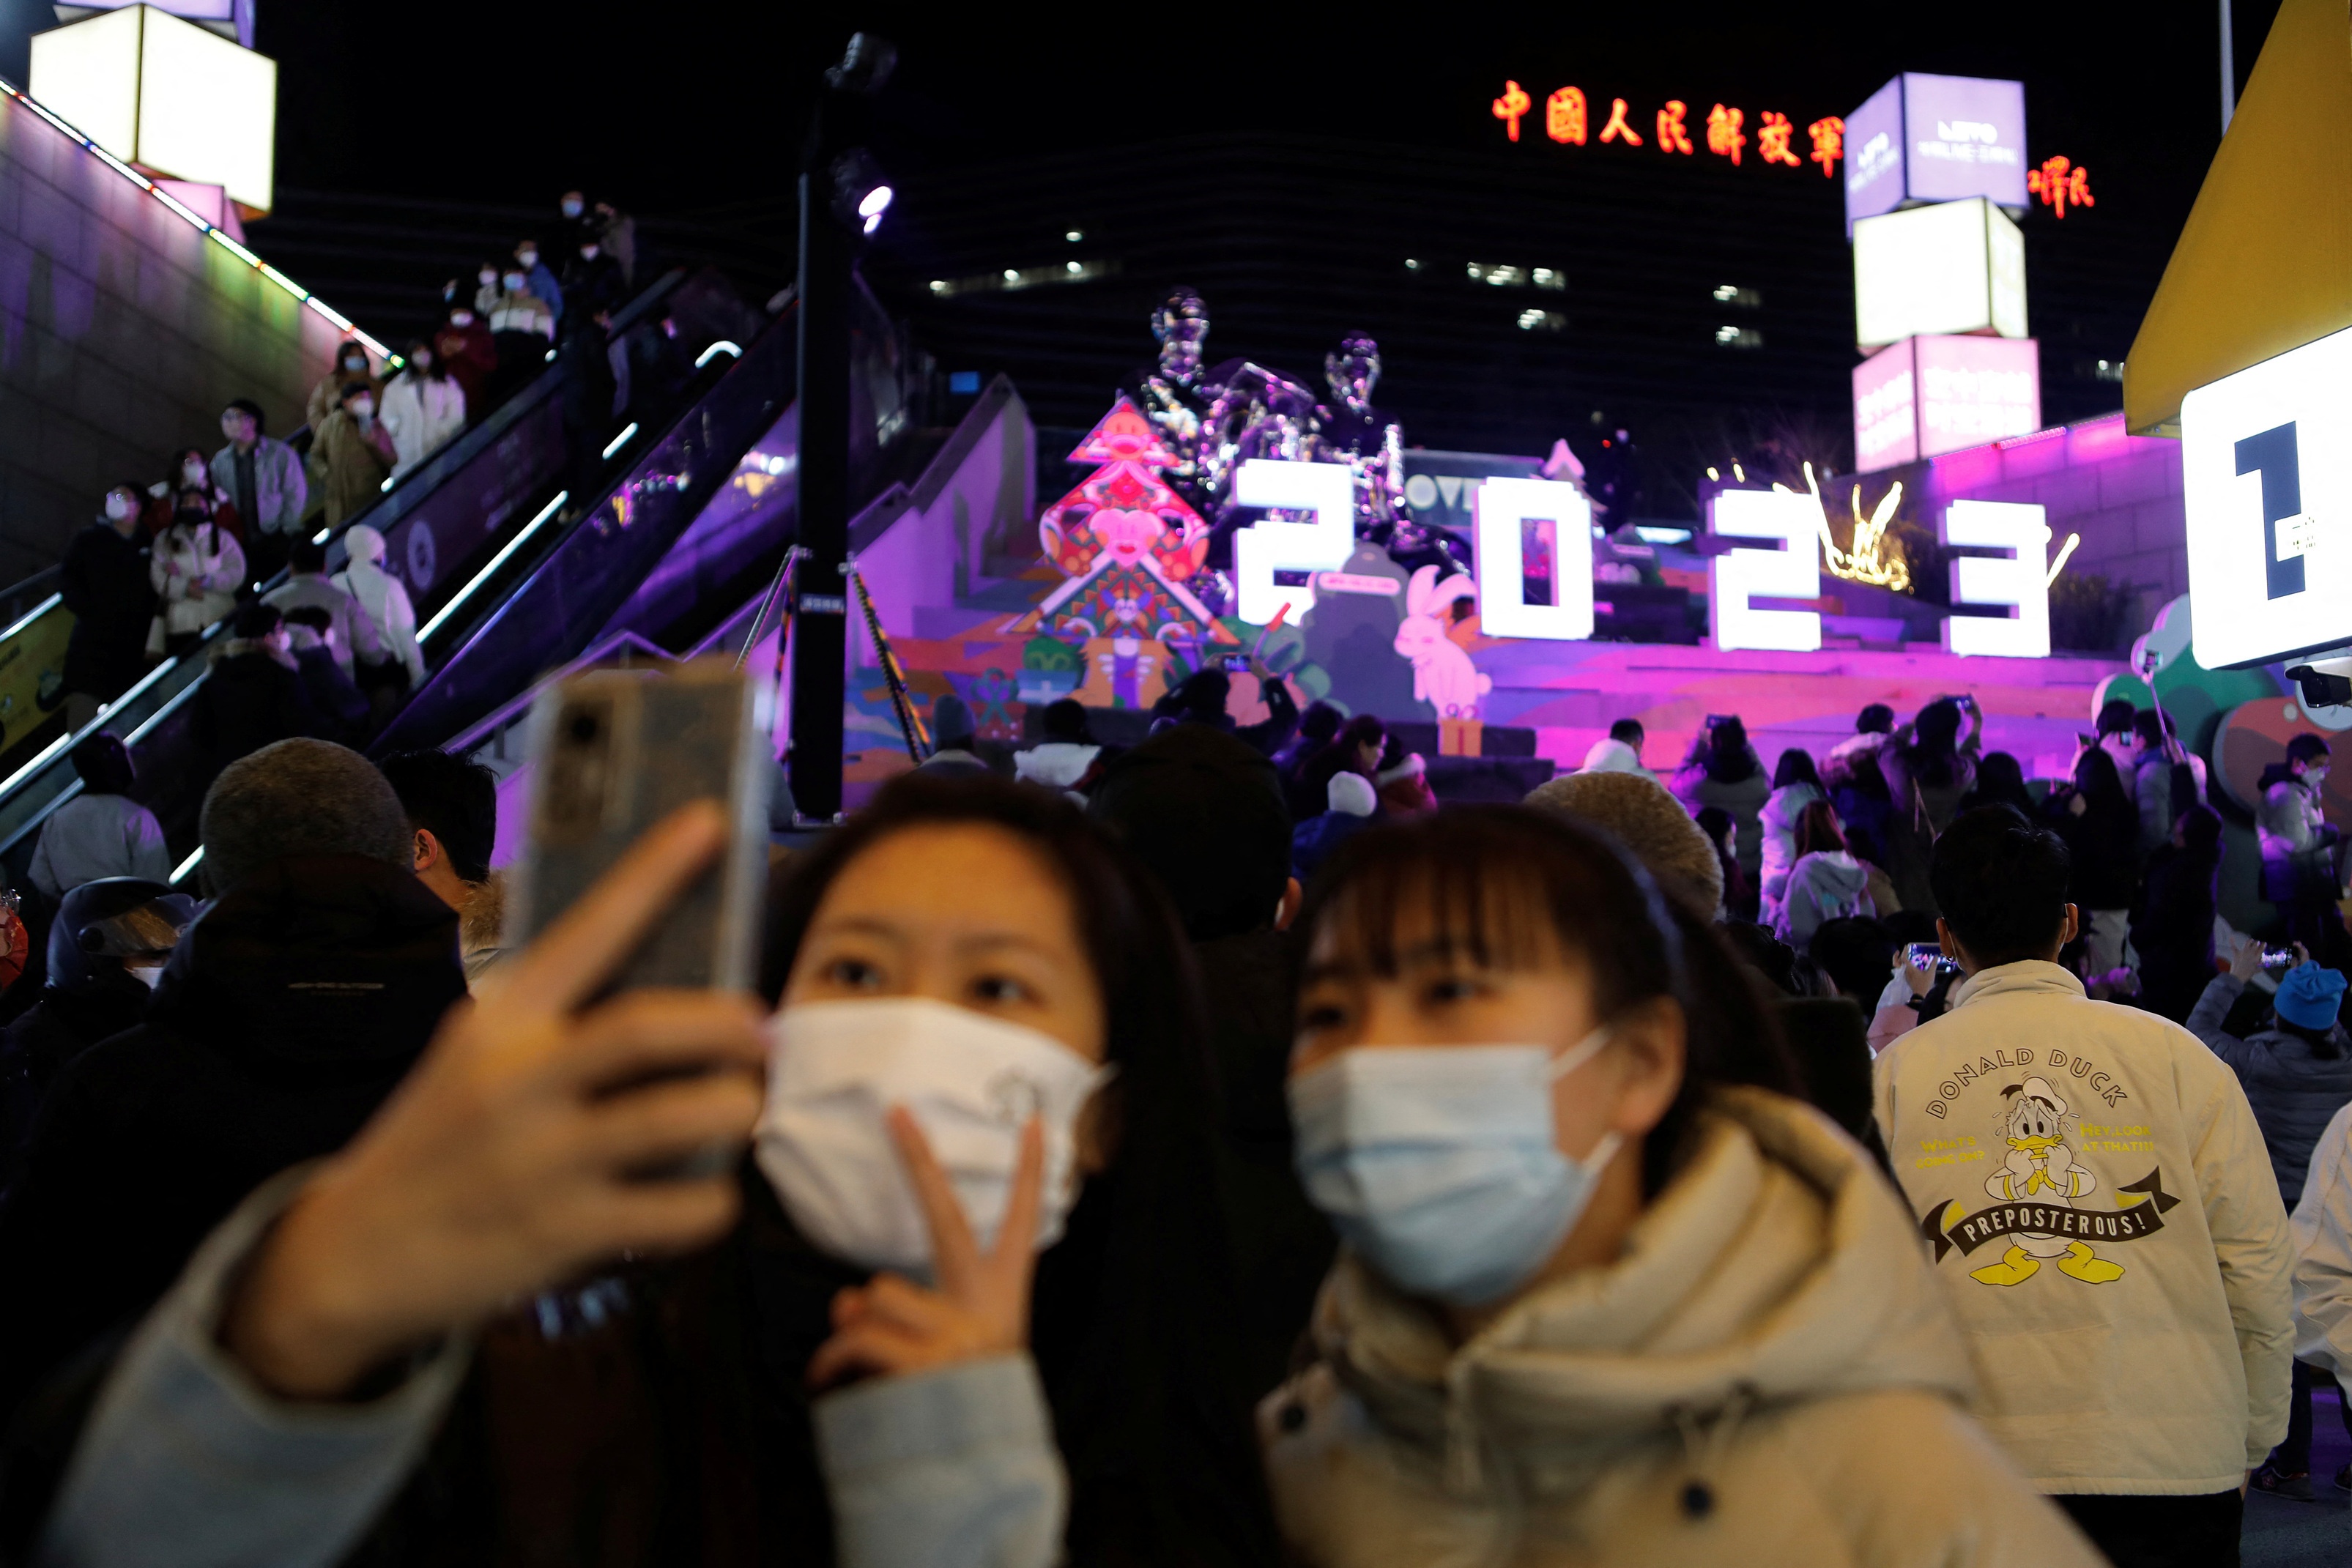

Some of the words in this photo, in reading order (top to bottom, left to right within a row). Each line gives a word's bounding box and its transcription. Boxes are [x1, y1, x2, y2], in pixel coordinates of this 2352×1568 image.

[1493, 80, 1845, 178] 中國人民解放軍
[1926, 1047, 2034, 1120] DONALD
[2049, 1049, 2128, 1108] DUCK
[1915, 1153, 1956, 1170] GOING
[1958, 1151, 1986, 1163] ON?
[2082, 1141, 2099, 1152] AT
[1963, 1208, 2146, 1242] PREPOSTEROUS!
